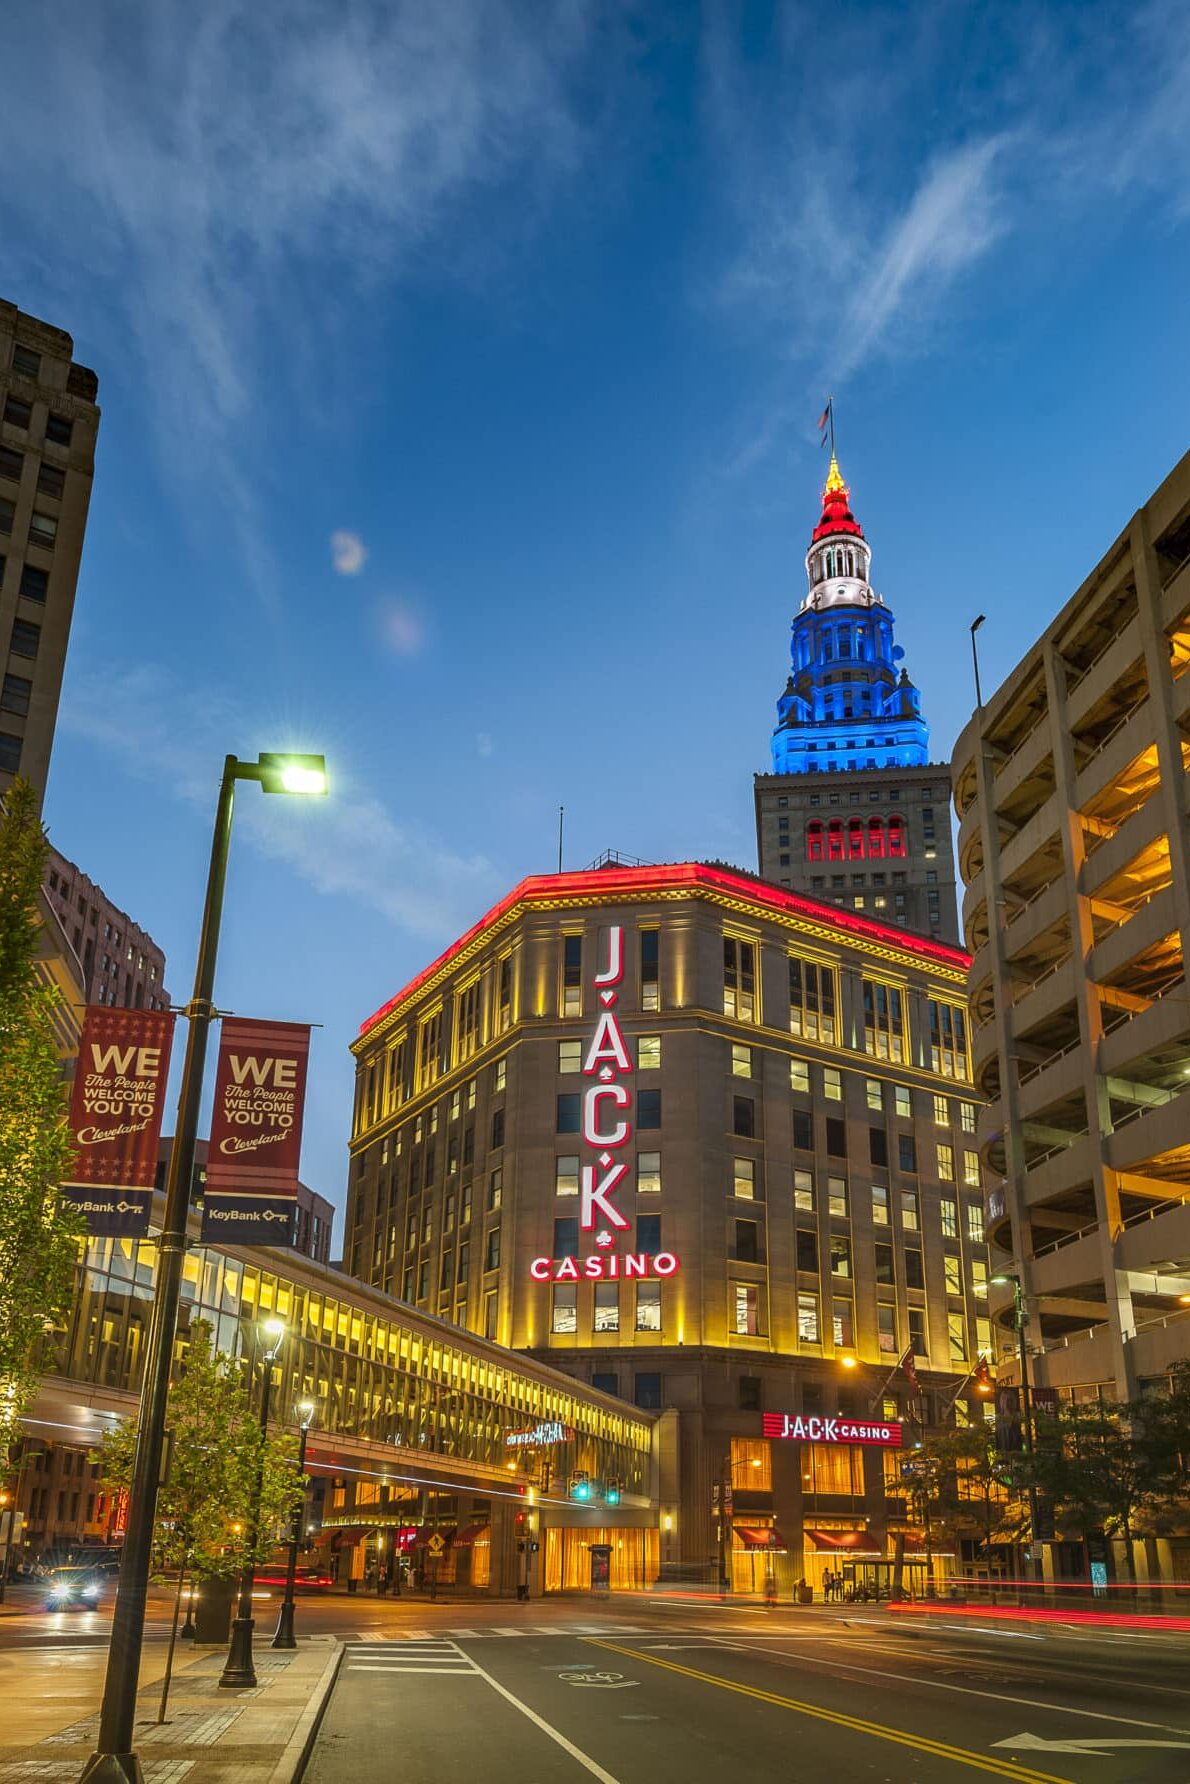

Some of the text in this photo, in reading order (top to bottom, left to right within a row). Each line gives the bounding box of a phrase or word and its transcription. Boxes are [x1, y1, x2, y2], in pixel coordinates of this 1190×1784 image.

[91, 1044, 161, 1077] WE
[229, 1055, 298, 1088] WE
[581, 926, 632, 1230] JACK
[85, 1074, 156, 1091] The People
[84, 1088, 155, 1102] WELCOME
[225, 1085, 294, 1102] The People
[83, 1100, 154, 1117] YOU TO
[224, 1099, 295, 1113] WELCOME
[224, 1110, 293, 1127] YOU TO
[77, 1119, 152, 1144] Cleveland
[220, 1129, 292, 1154] Cleveland
[209, 1209, 261, 1221] KeyBank
[530, 1252, 680, 1280] CASINO
[841, 1426, 890, 1439] CASINO
